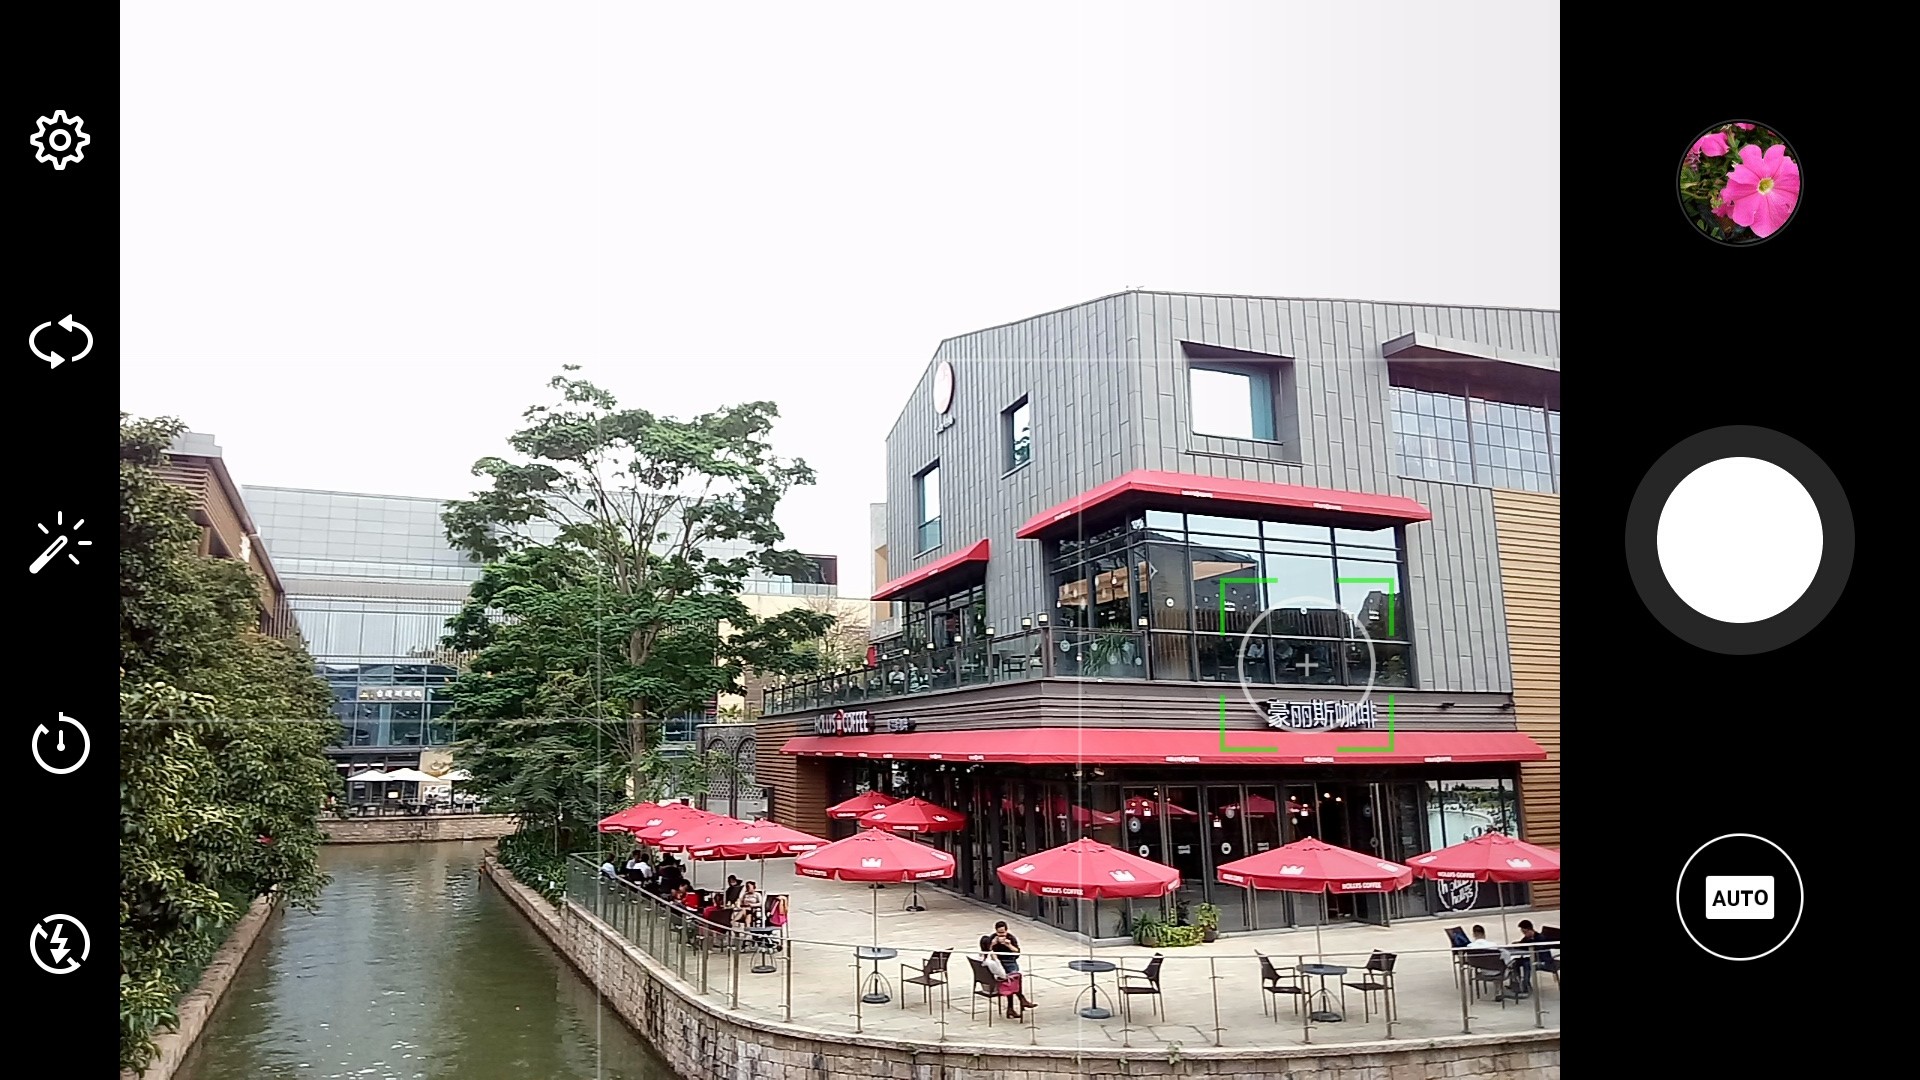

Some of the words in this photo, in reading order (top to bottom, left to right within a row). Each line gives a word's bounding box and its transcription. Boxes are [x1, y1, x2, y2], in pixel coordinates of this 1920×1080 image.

[842, 710, 868, 733] COFFEE
[1266, 699, 1378, 729] 豪丽斯咖啡
